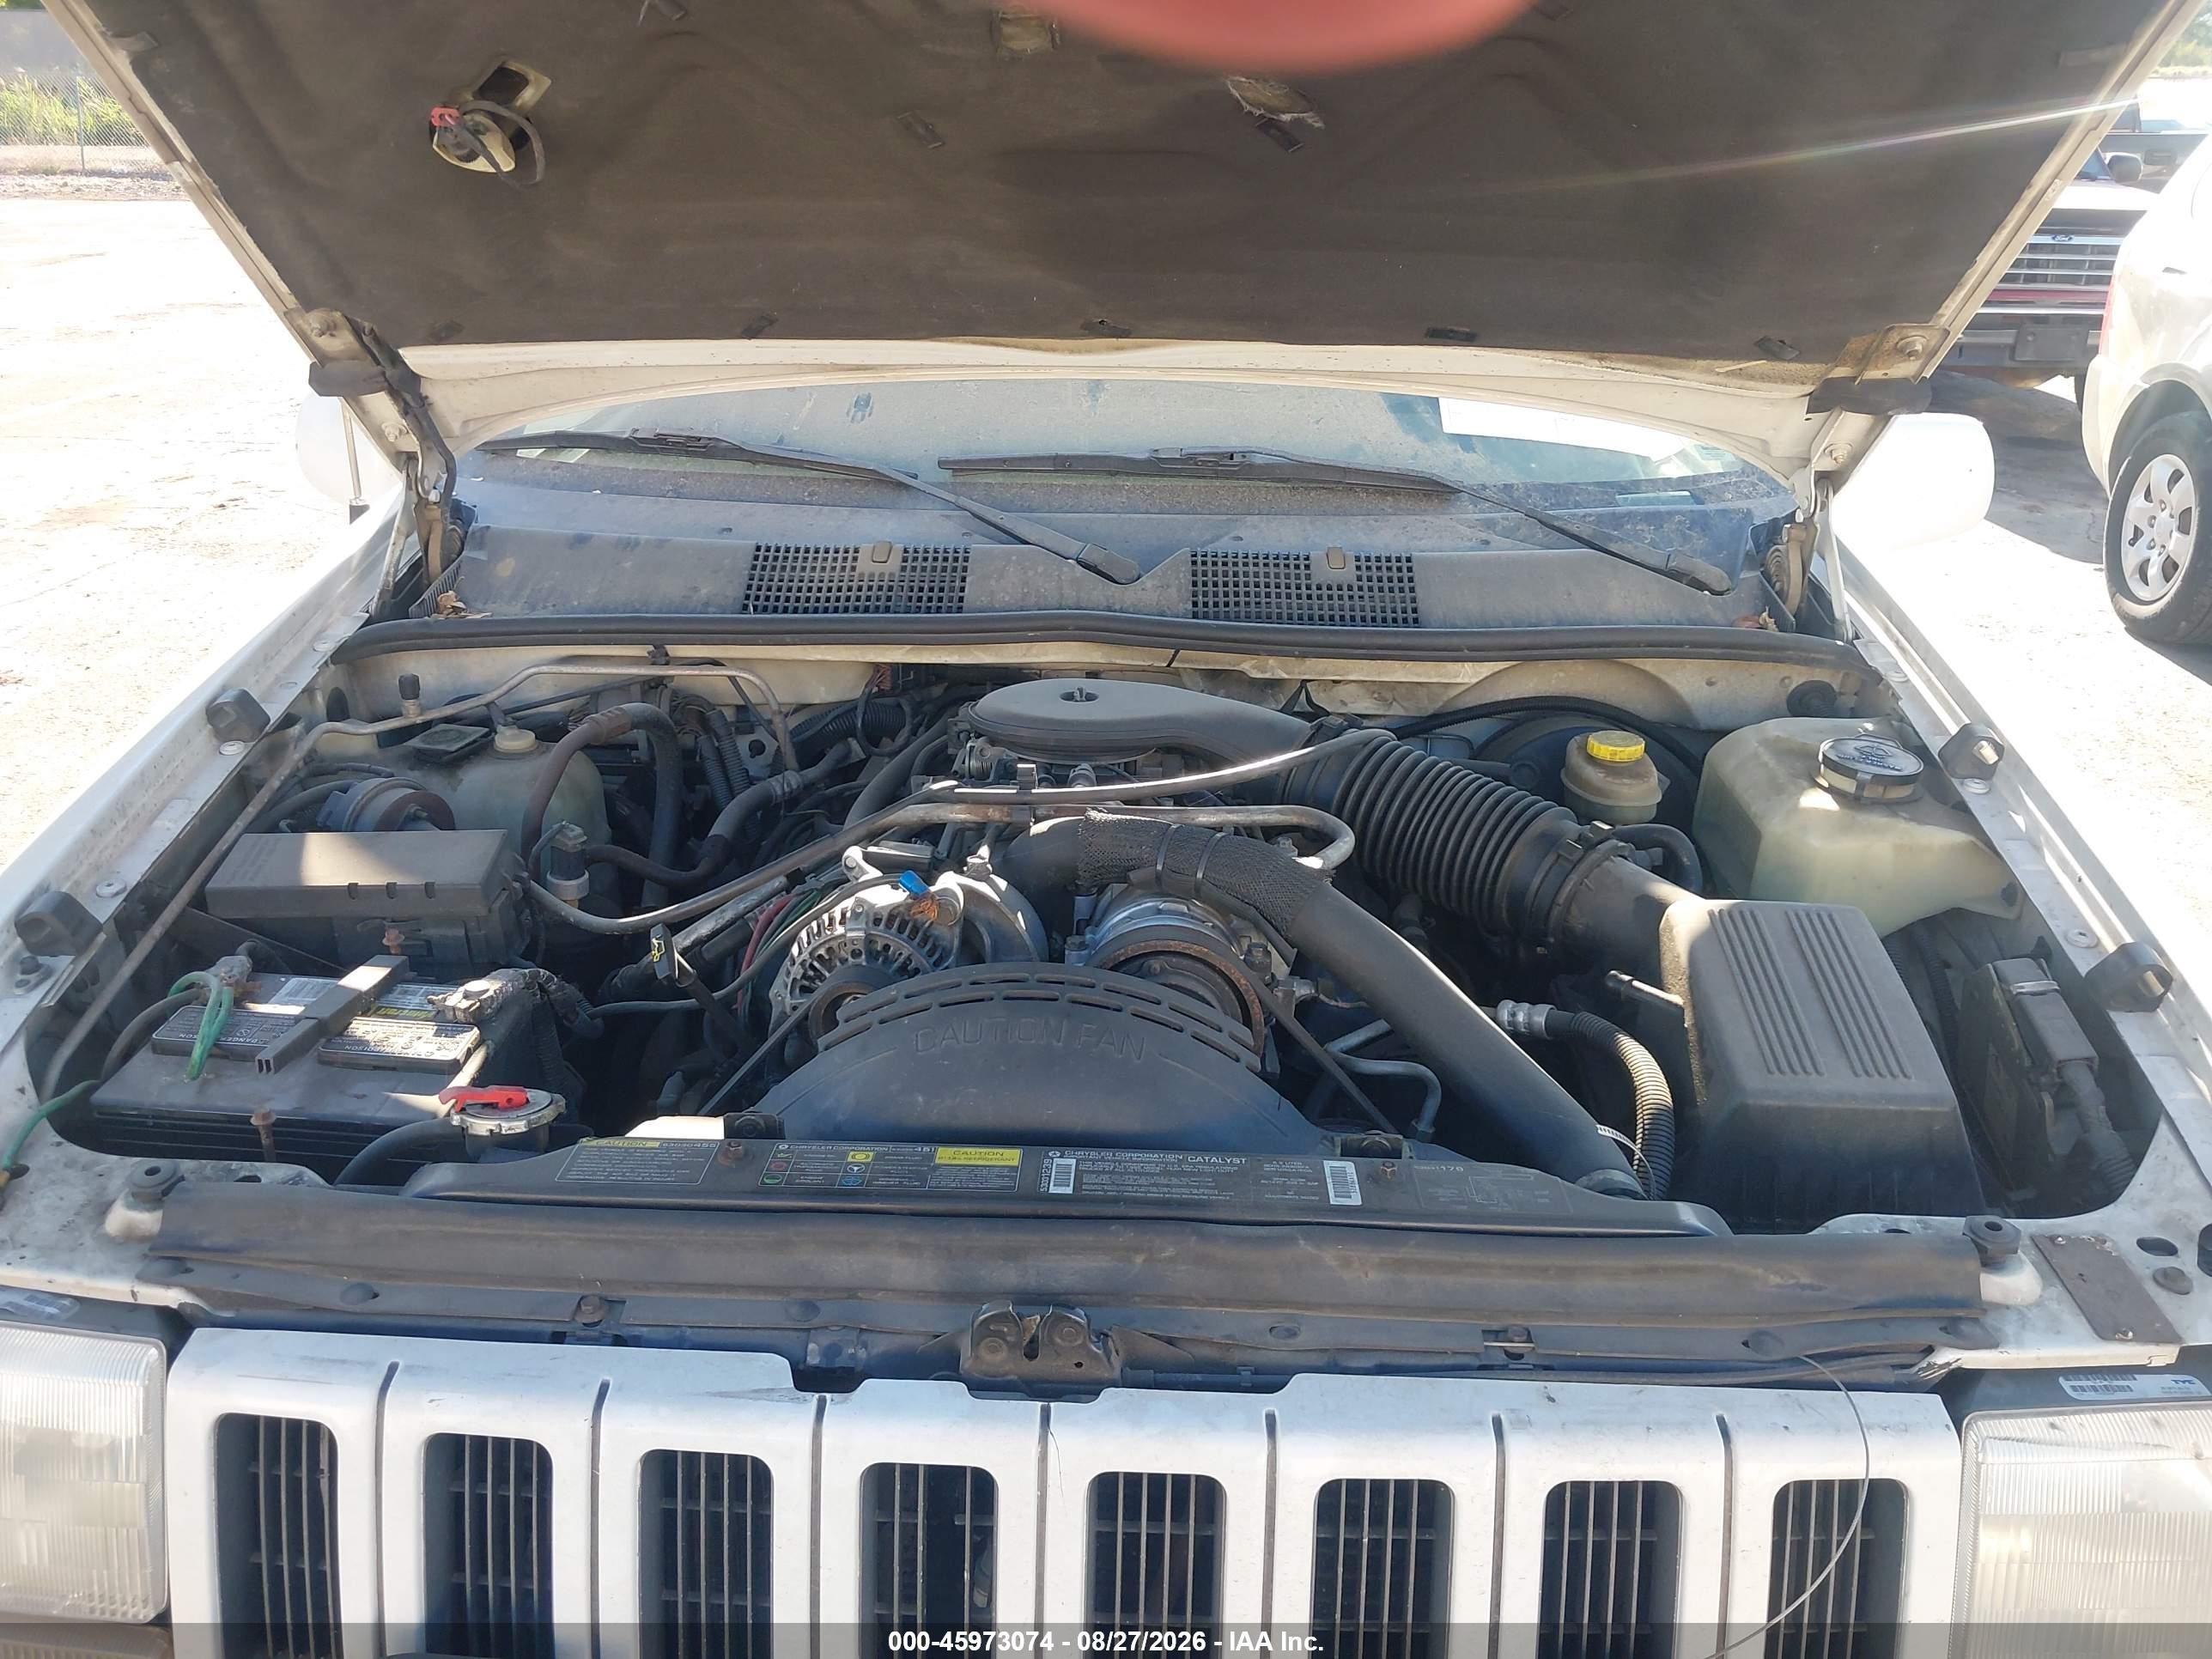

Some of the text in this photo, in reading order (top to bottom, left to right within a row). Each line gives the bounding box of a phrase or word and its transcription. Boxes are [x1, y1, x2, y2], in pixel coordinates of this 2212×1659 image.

[915, 1017, 1147, 1062] CAUTION FAN
[1115, 1152, 1183, 1160] CORPORATION
[1188, 1156, 1248, 1164] CATALYST
